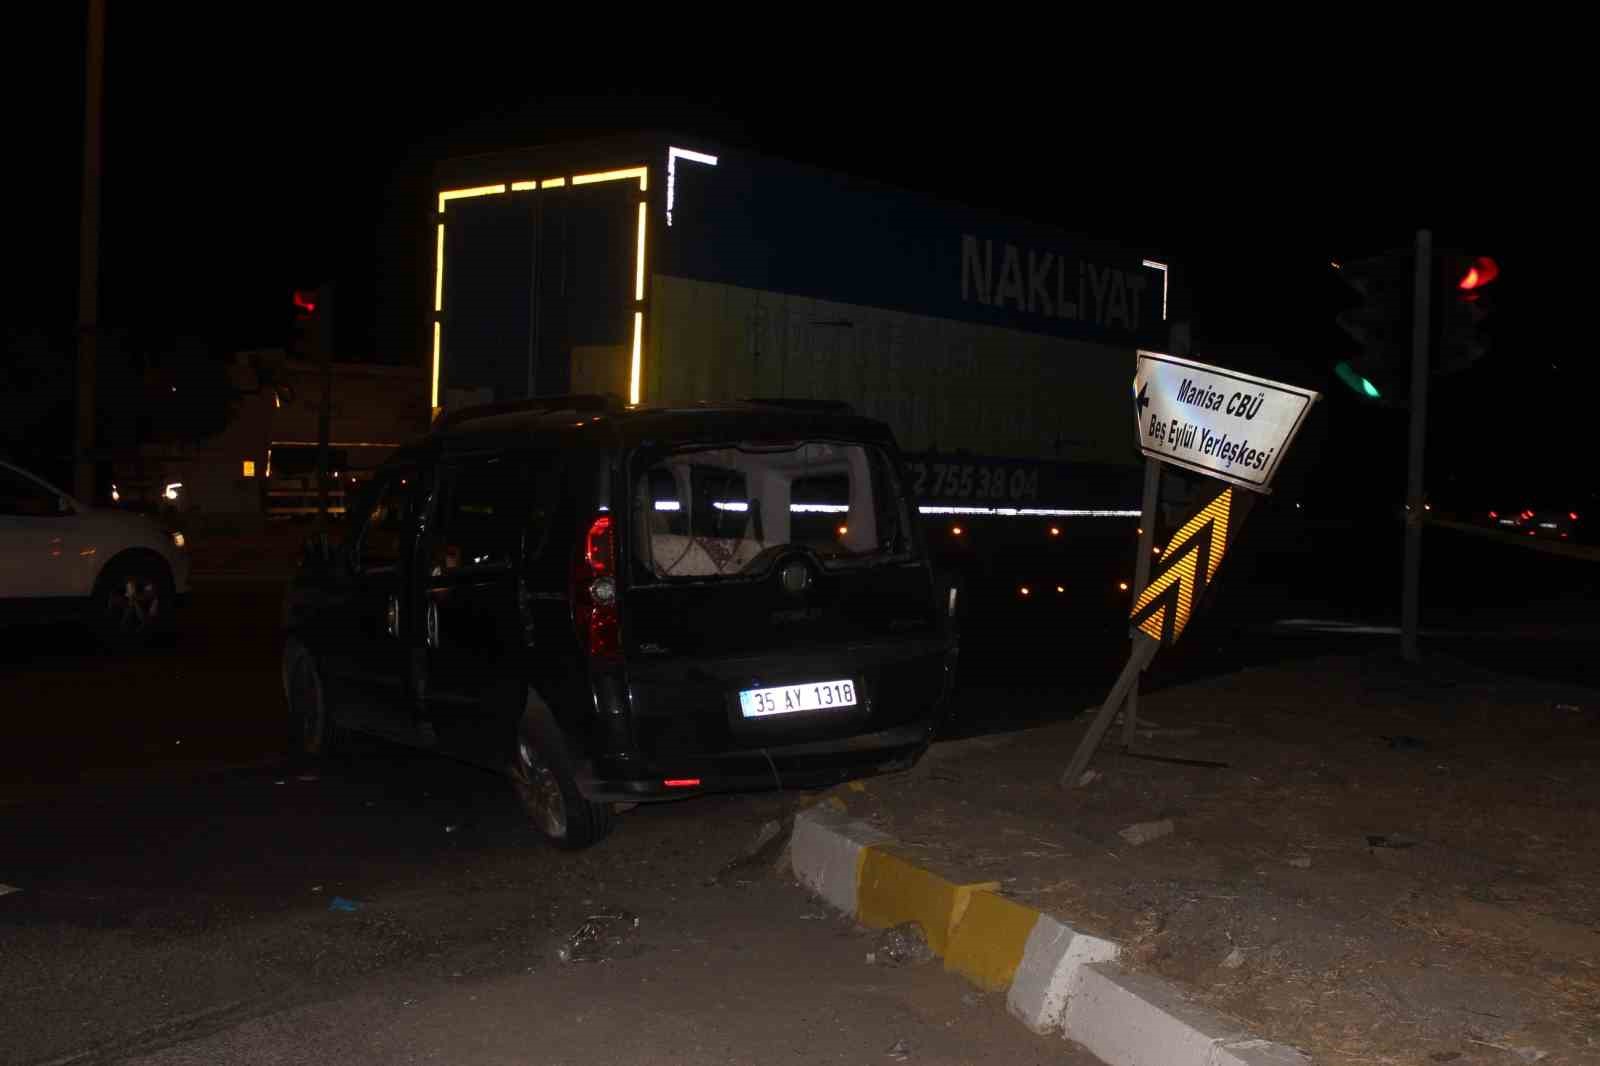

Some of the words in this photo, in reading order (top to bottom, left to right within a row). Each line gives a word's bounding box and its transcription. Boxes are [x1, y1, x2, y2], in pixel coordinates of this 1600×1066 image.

[1176, 378, 1221, 412] Manisa
[1225, 392, 1265, 421] CBÜ
[1149, 413, 1166, 446] Beş
[1167, 419, 1199, 451] Eylül
[1198, 427, 1275, 468] Yerleşkesi
[754, 692, 776, 713] 35
[784, 689, 801, 710] AY
[814, 683, 853, 706] 1318
